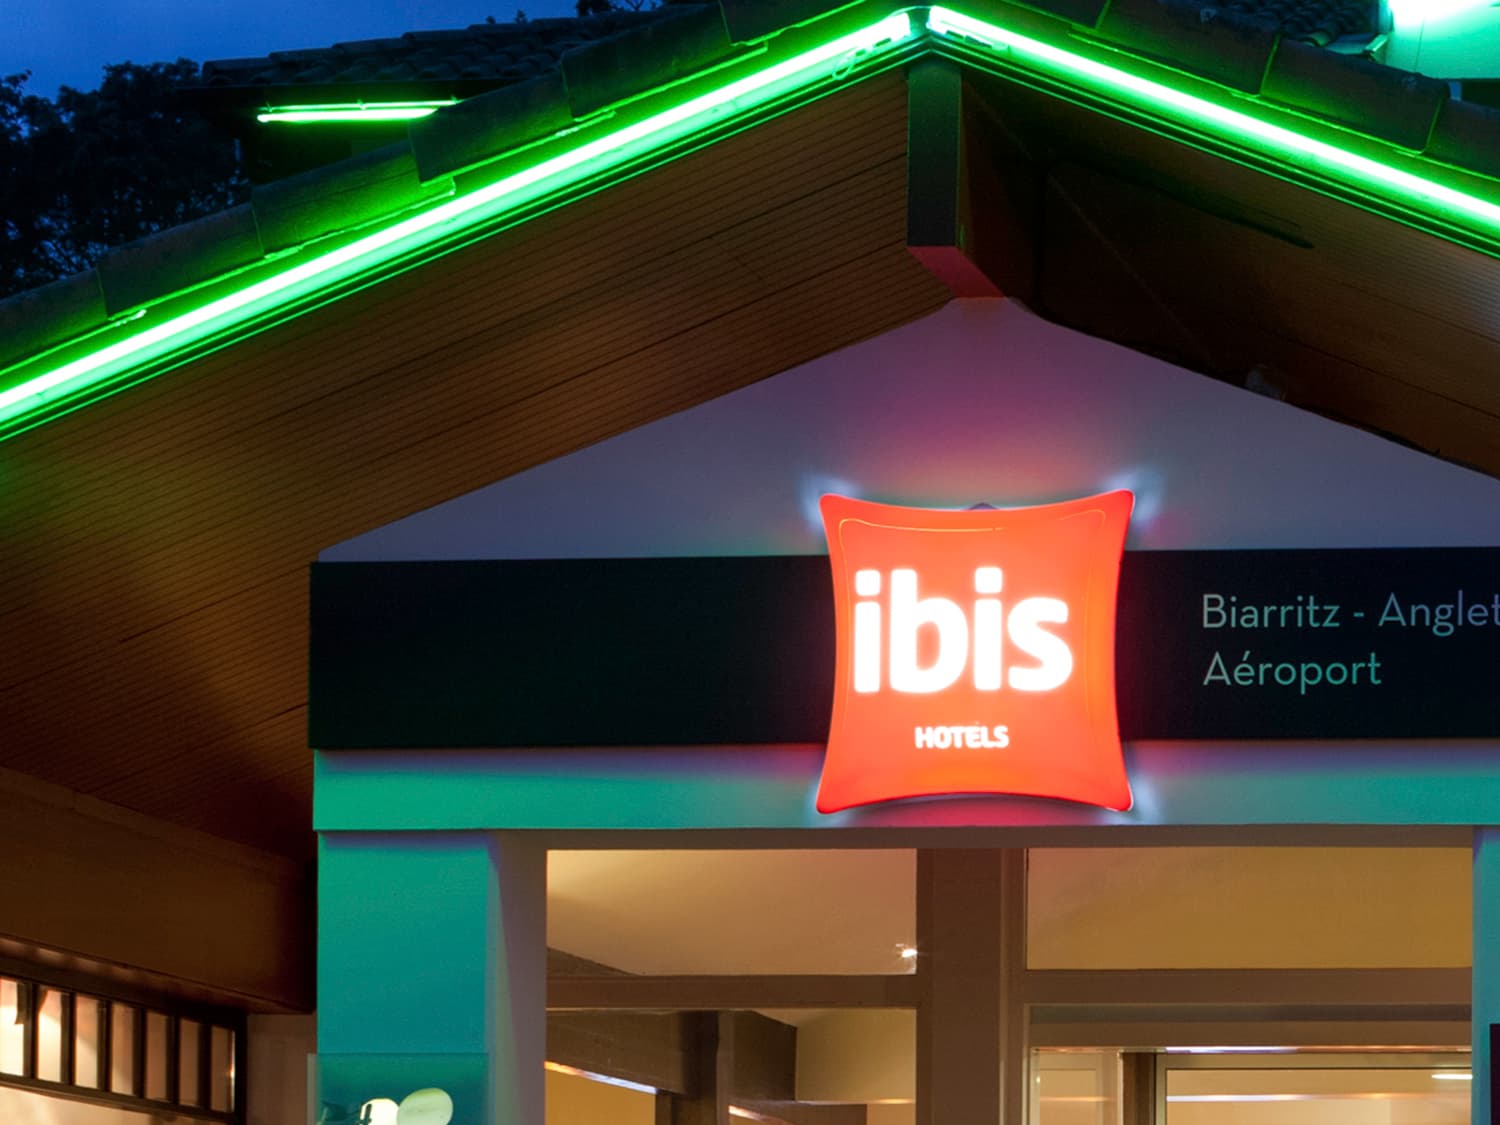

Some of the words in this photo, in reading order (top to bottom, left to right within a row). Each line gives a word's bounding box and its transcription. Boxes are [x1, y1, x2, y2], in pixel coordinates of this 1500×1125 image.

[854, 566, 1073, 694] ibis
[1202, 593, 1341, 629] Biarritz
[1203, 650, 1383, 695] Aéroport
[914, 724, 1010, 749] HOTELS
